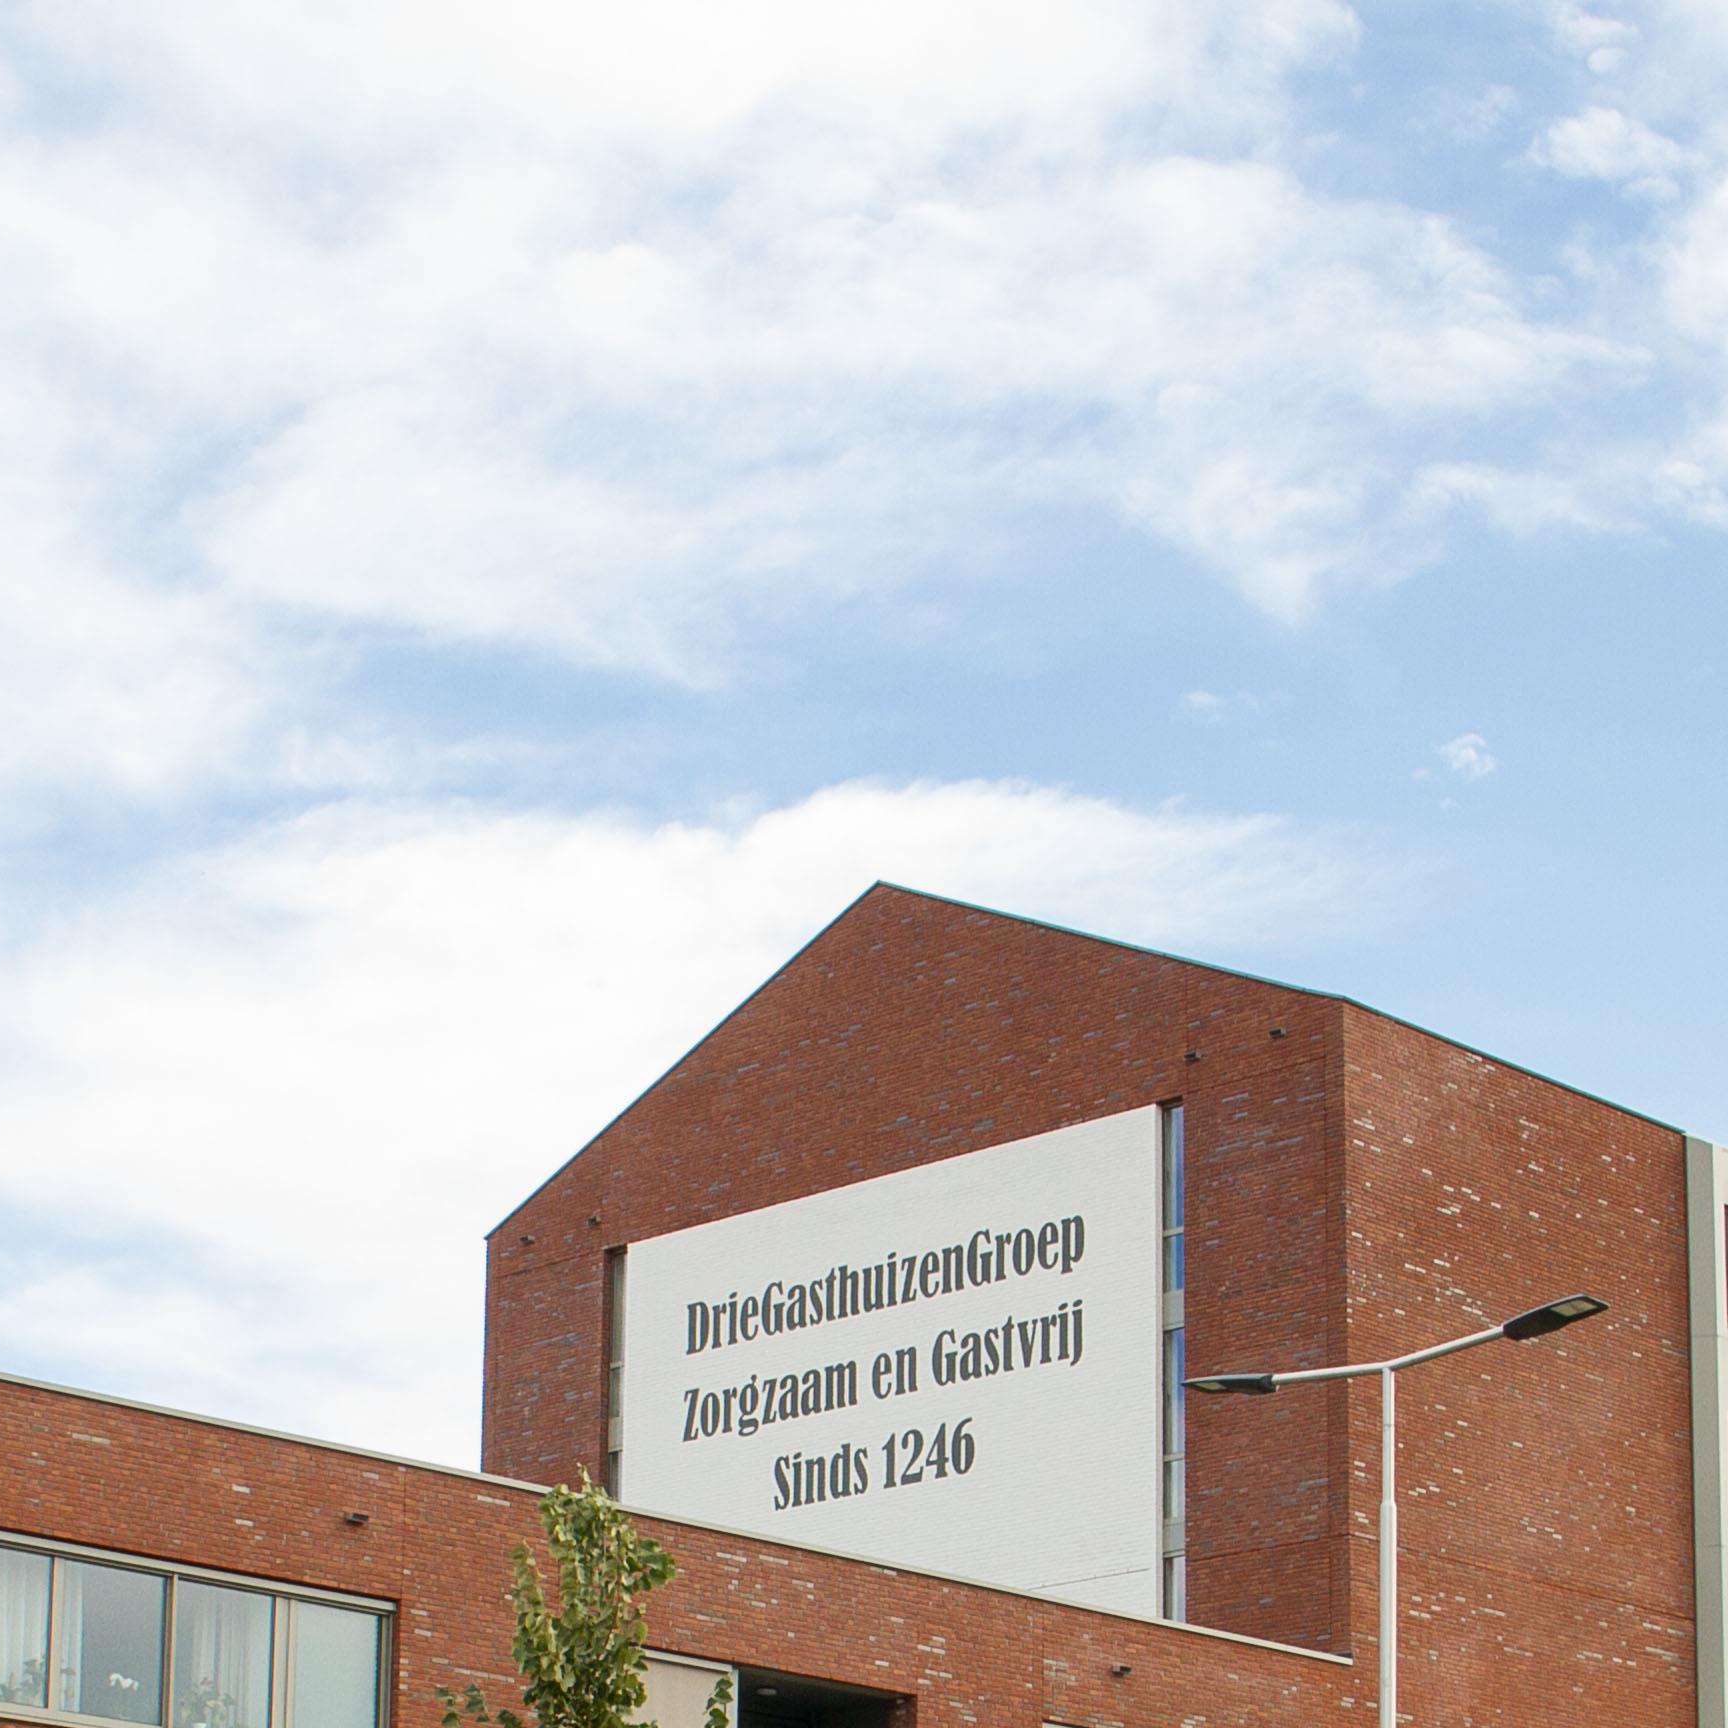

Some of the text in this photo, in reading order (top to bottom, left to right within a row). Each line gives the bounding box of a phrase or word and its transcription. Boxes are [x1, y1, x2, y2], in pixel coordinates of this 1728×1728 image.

[685, 1215, 1085, 1356] DrieGasthuizenGroep
[682, 1299, 1084, 1442] Zorgzaam en Gastvrij
[773, 1417, 975, 1511] Sinds 1246
